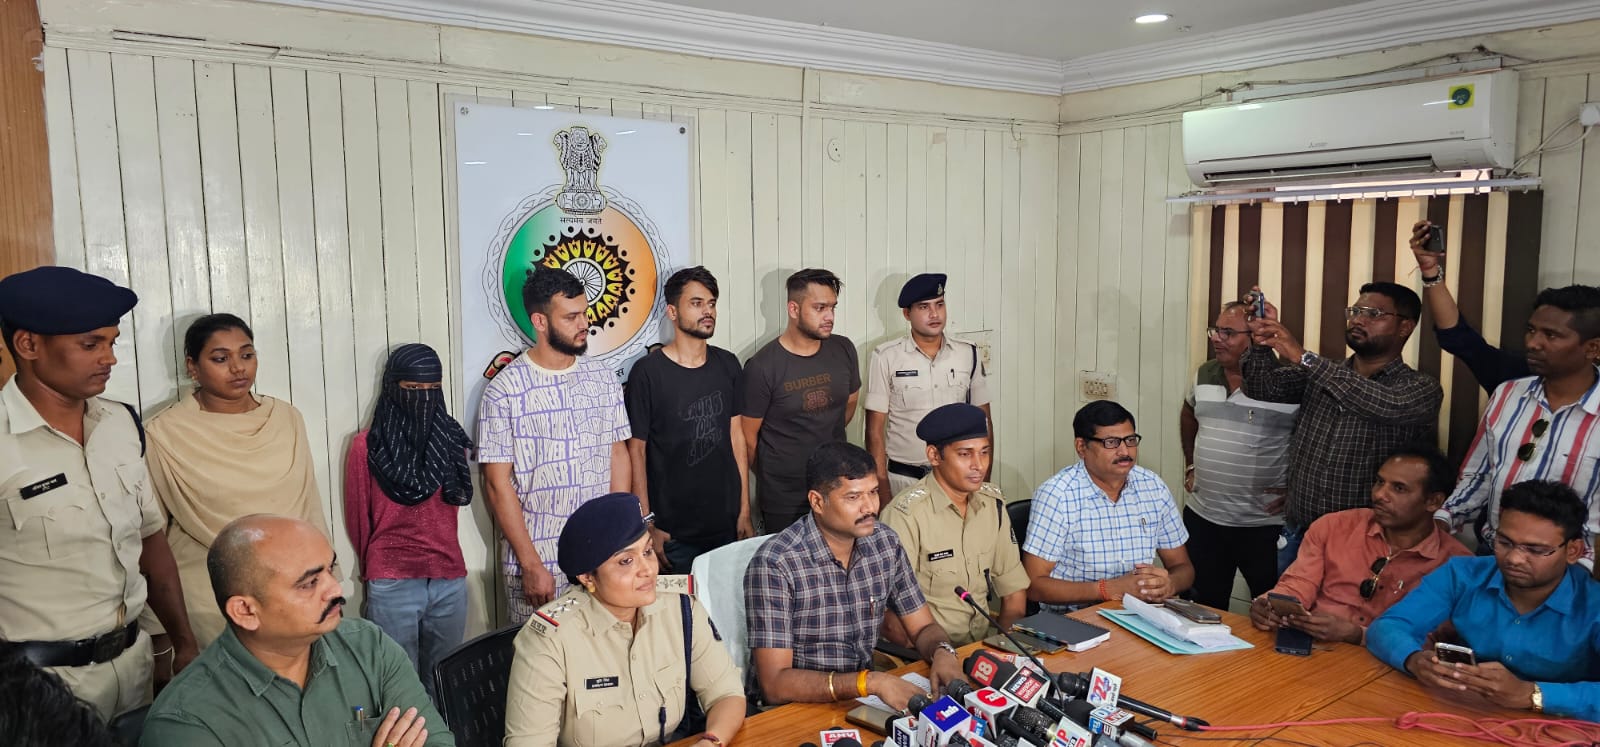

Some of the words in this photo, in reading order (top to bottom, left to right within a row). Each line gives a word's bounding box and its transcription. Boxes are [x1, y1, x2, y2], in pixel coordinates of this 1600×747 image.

[784, 373, 832, 392] BURBER
[974, 661, 993, 682] 18
[1010, 675, 1028, 693] NEWS
